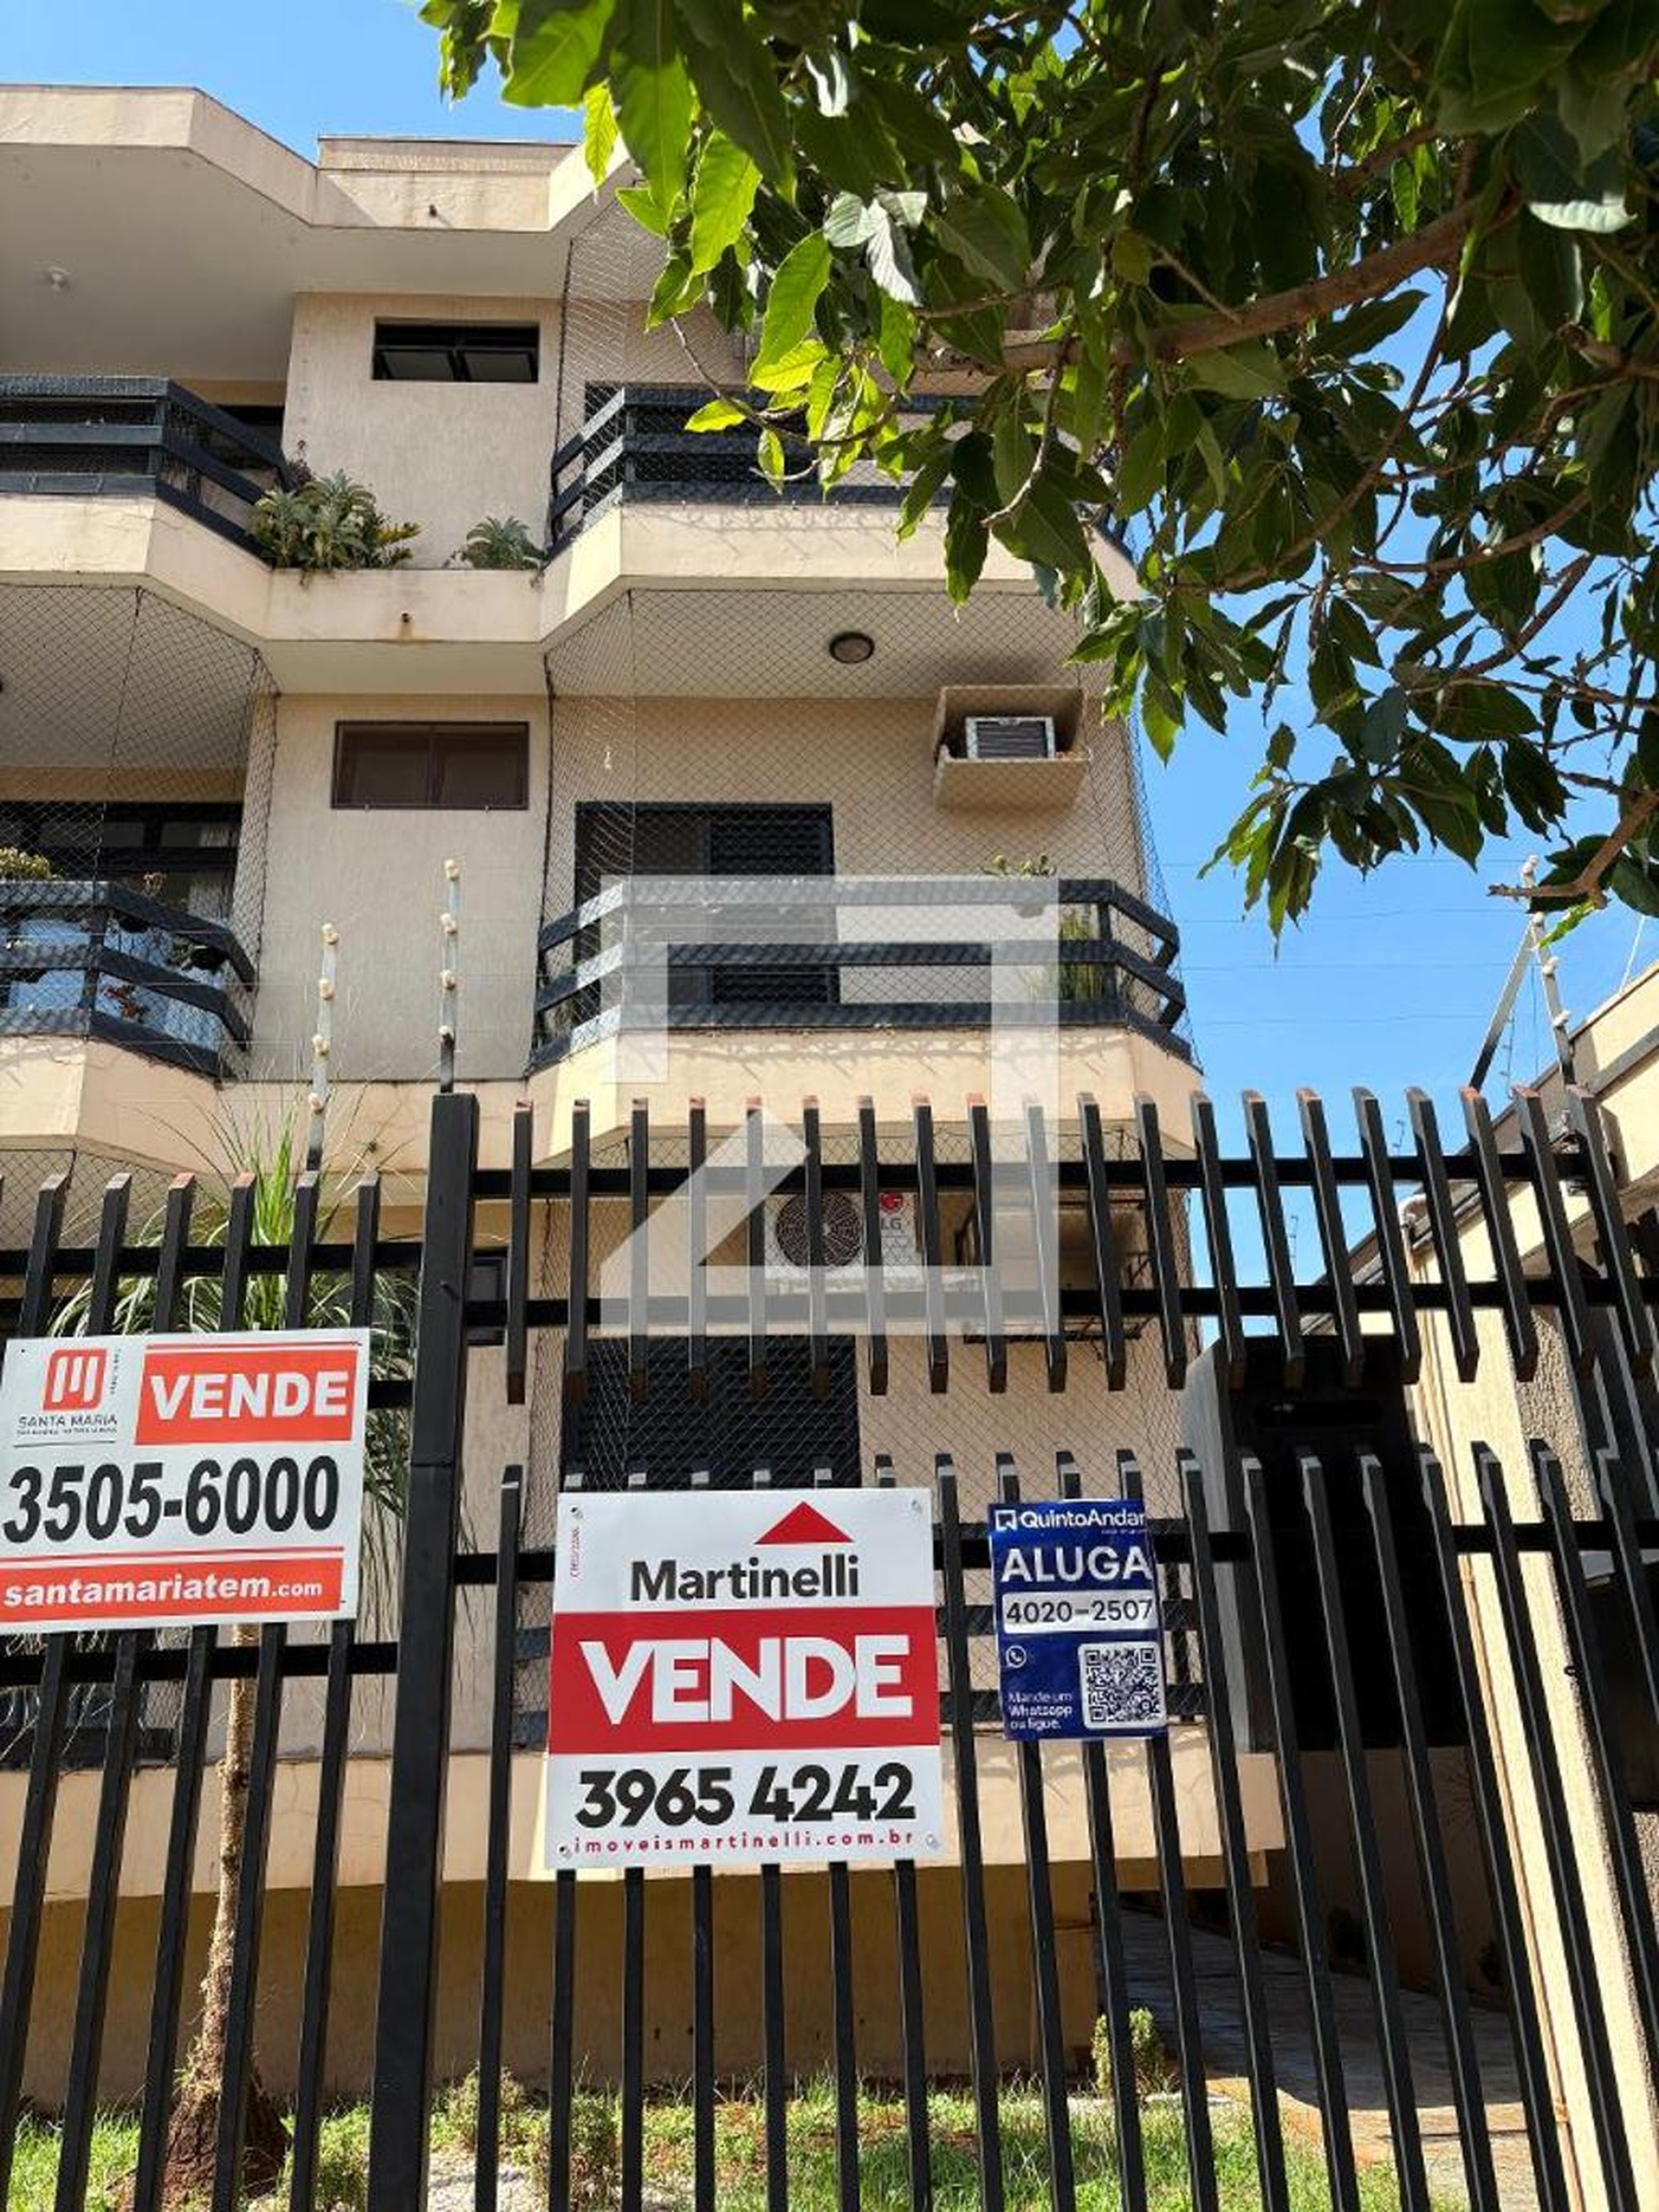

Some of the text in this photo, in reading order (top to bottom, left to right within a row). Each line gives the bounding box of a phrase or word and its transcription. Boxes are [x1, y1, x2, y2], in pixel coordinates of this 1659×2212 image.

[151, 1371, 348, 1420] VENDE
[19, 1414, 118, 1427] SANTA MARIA
[2, 1455, 339, 1544] 3505-6000
[1020, 1509, 1144, 1528] QuintoAndar
[631, 1553, 859, 1601] Martinelli
[1000, 1546, 1153, 1582] ALUGA
[3, 1573, 323, 1607] santamariatem.com
[1007, 1599, 1153, 1623] 4020-2507
[580, 1634, 913, 1725] VENDE
[575, 1762, 916, 1828] 3965 4242
[574, 1830, 914, 1853] imoveismartinelli.com.br
